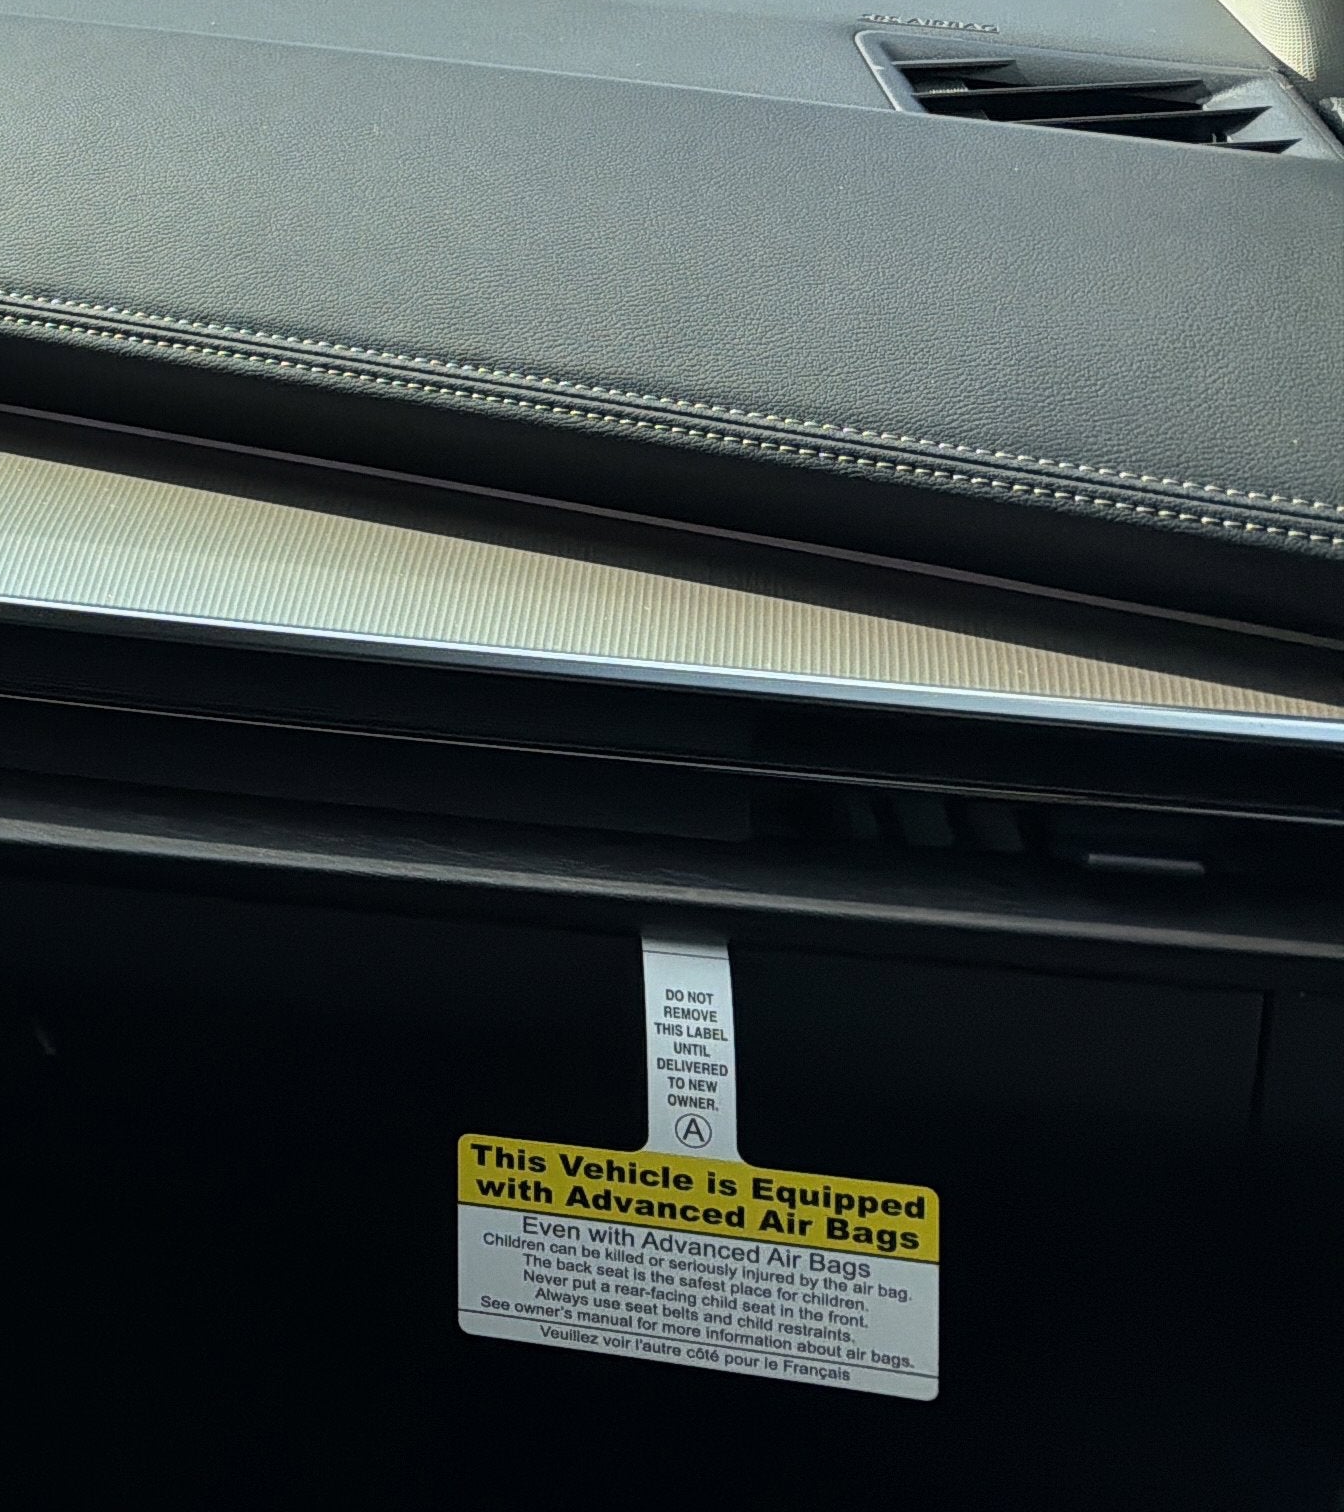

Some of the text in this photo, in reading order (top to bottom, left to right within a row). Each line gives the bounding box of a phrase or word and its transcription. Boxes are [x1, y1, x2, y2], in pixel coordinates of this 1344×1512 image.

[663, 1005, 718, 1023] REMOVE
[665, 988, 714, 1006] DO NOT
[654, 1022, 728, 1042] THIS LABEL
[673, 1041, 710, 1058] UNTIL
[656, 1057, 728, 1077] DELIVERED
[667, 1076, 718, 1094] TO NEW
[667, 1093, 719, 1112] OWNER.
[682, 1117, 705, 1142] A
[470, 1143, 925, 1219] This Vehicle is Equipped
[476, 1178, 920, 1252] with Advanced Air Bags
[483, 1232, 912, 1303] Children can be killed or seriously injured by the air bag.
[522, 1215, 871, 1281] Even with Advanced Air Bags
[523, 1253, 869, 1312] The back seat is the safest place for children.
[523, 1269, 869, 1328] Never put a rear-facing child seat in the front.
[480, 1295, 915, 1370] See owner's manual for more information about air bags.
[535, 1287, 856, 1344] Always use seat belts and child restraints.
[540, 1325, 850, 1382] Veuillez voir l'autre côté pour le Français
